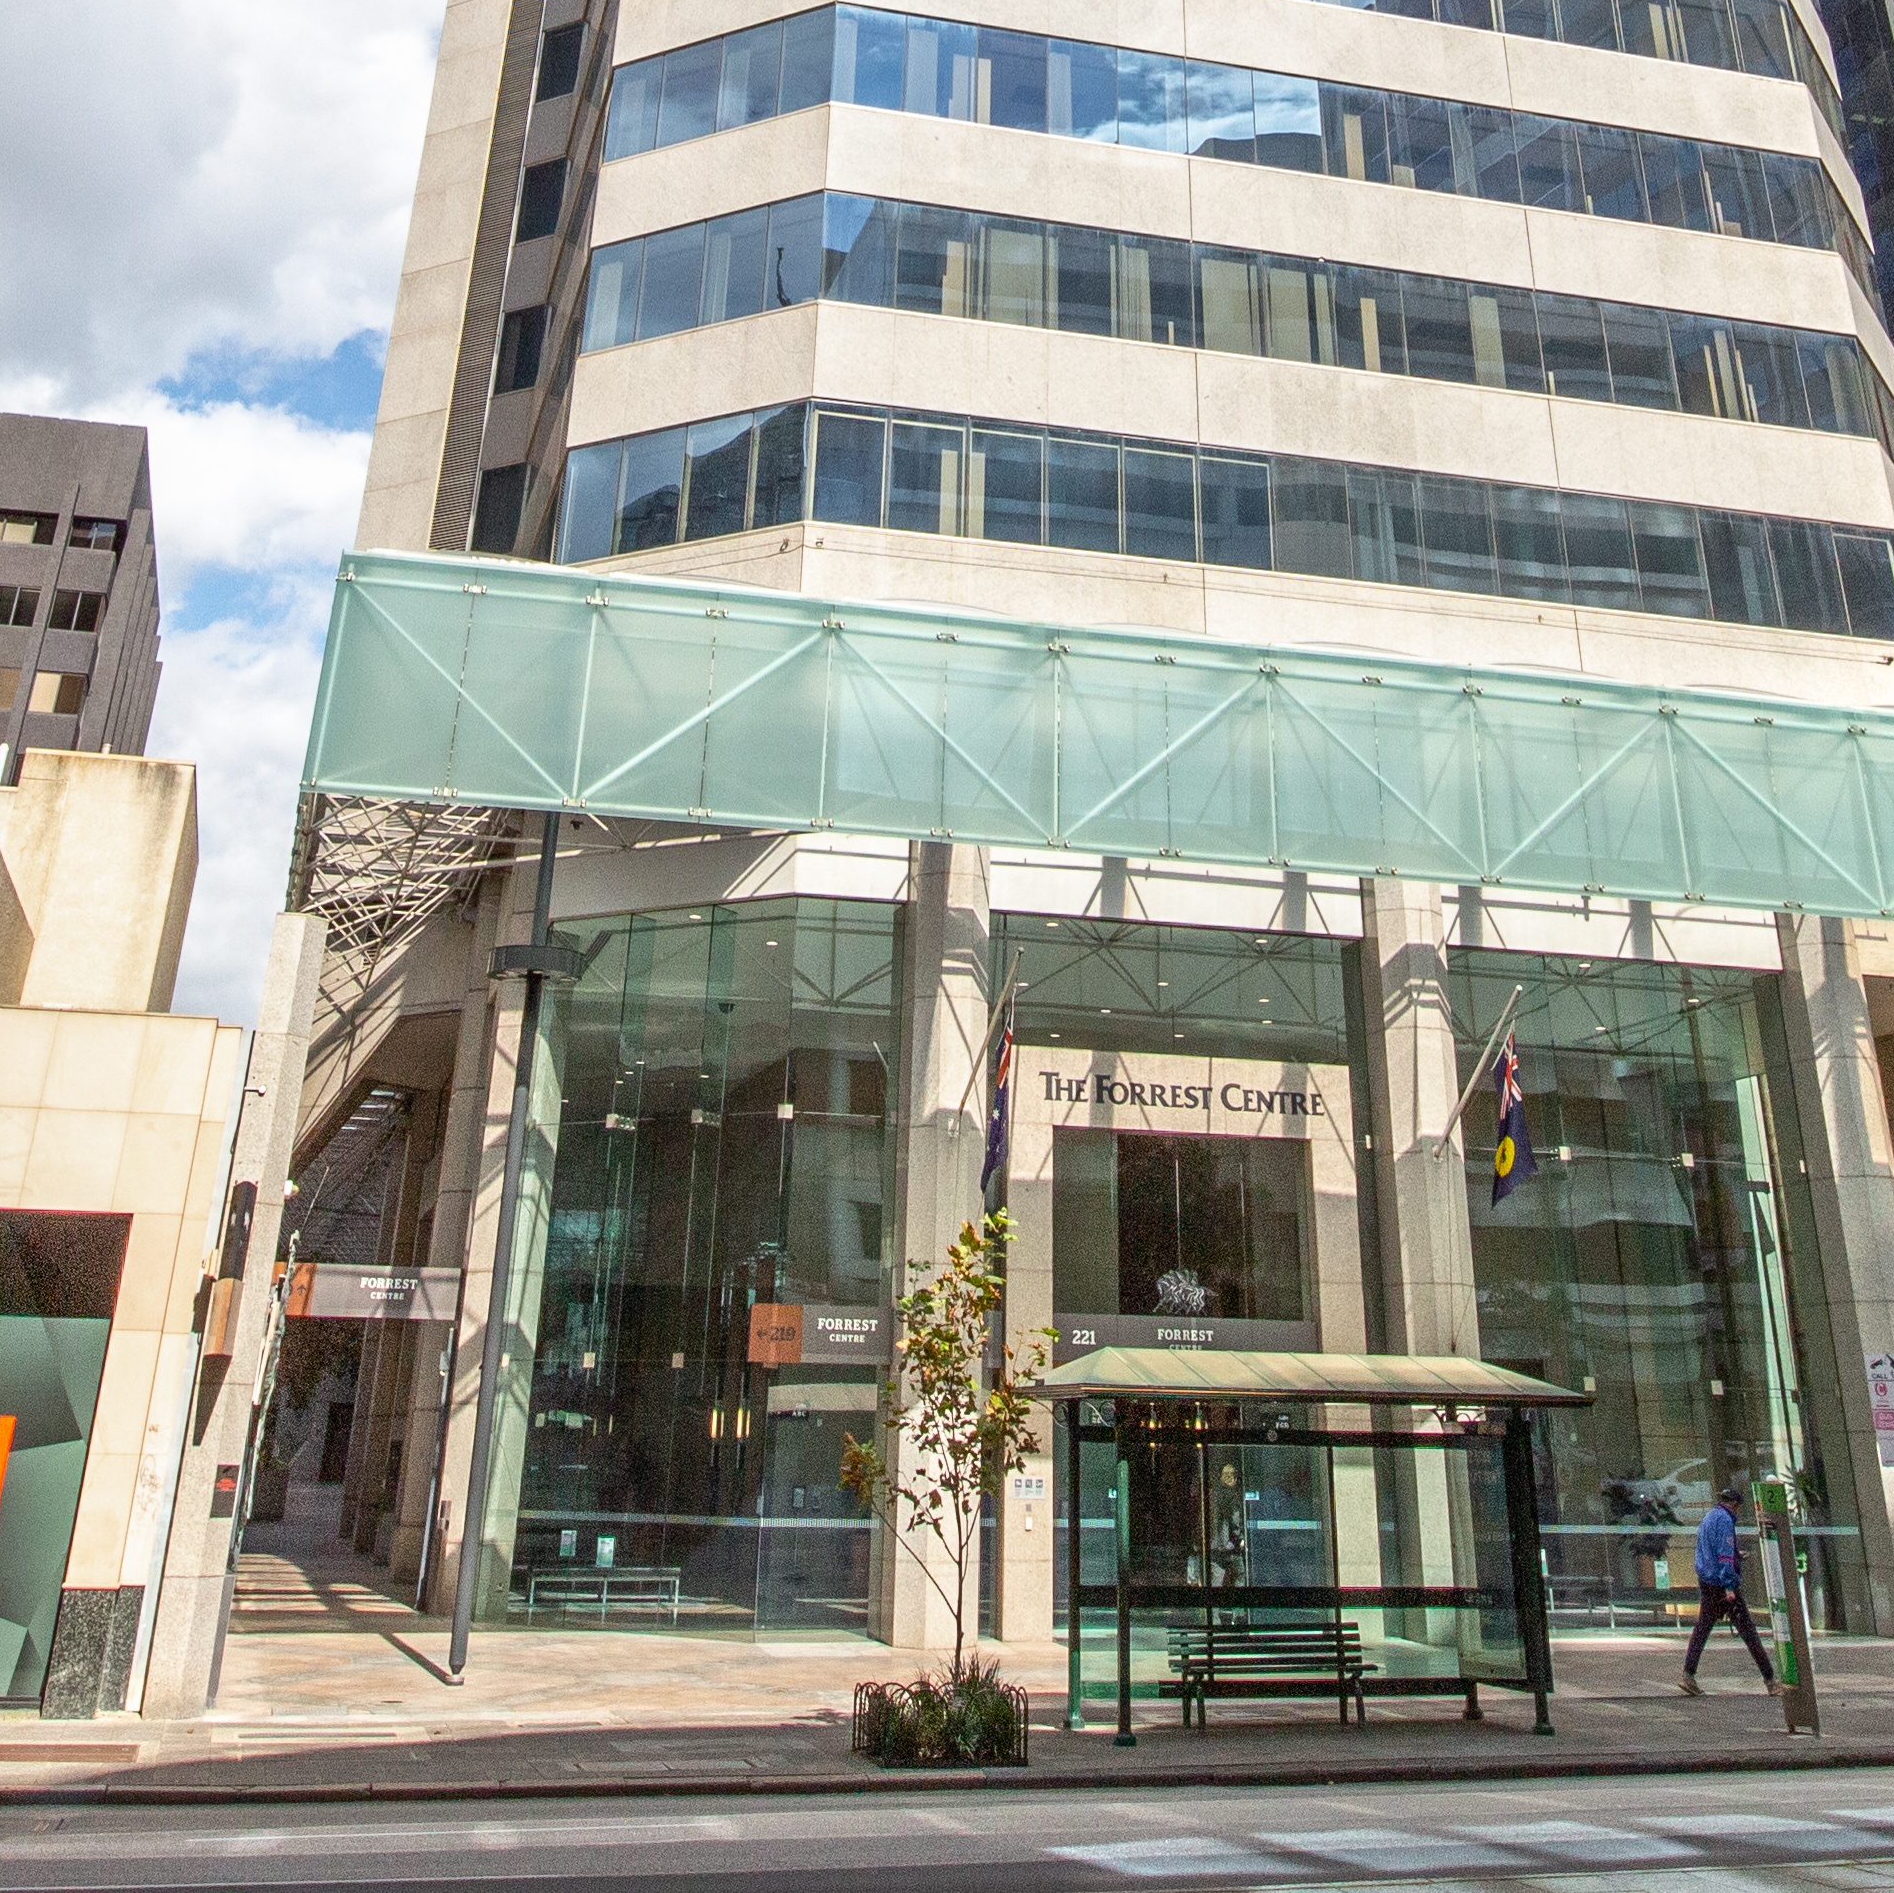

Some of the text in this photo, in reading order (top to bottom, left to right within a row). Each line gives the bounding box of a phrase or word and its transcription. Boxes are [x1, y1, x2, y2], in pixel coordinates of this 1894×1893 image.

[1039, 1070, 1326, 1116] THE FORREST CENTRE
[359, 1277, 418, 1290] FORREST
[370, 1291, 405, 1301] CENTRE
[818, 1317, 878, 1332] FORREST
[829, 1333, 866, 1343] CENTRE
[1072, 1329, 1097, 1345] 221
[1157, 1328, 1214, 1342] FORREST
[1767, 1490, 1776, 1504] 2
